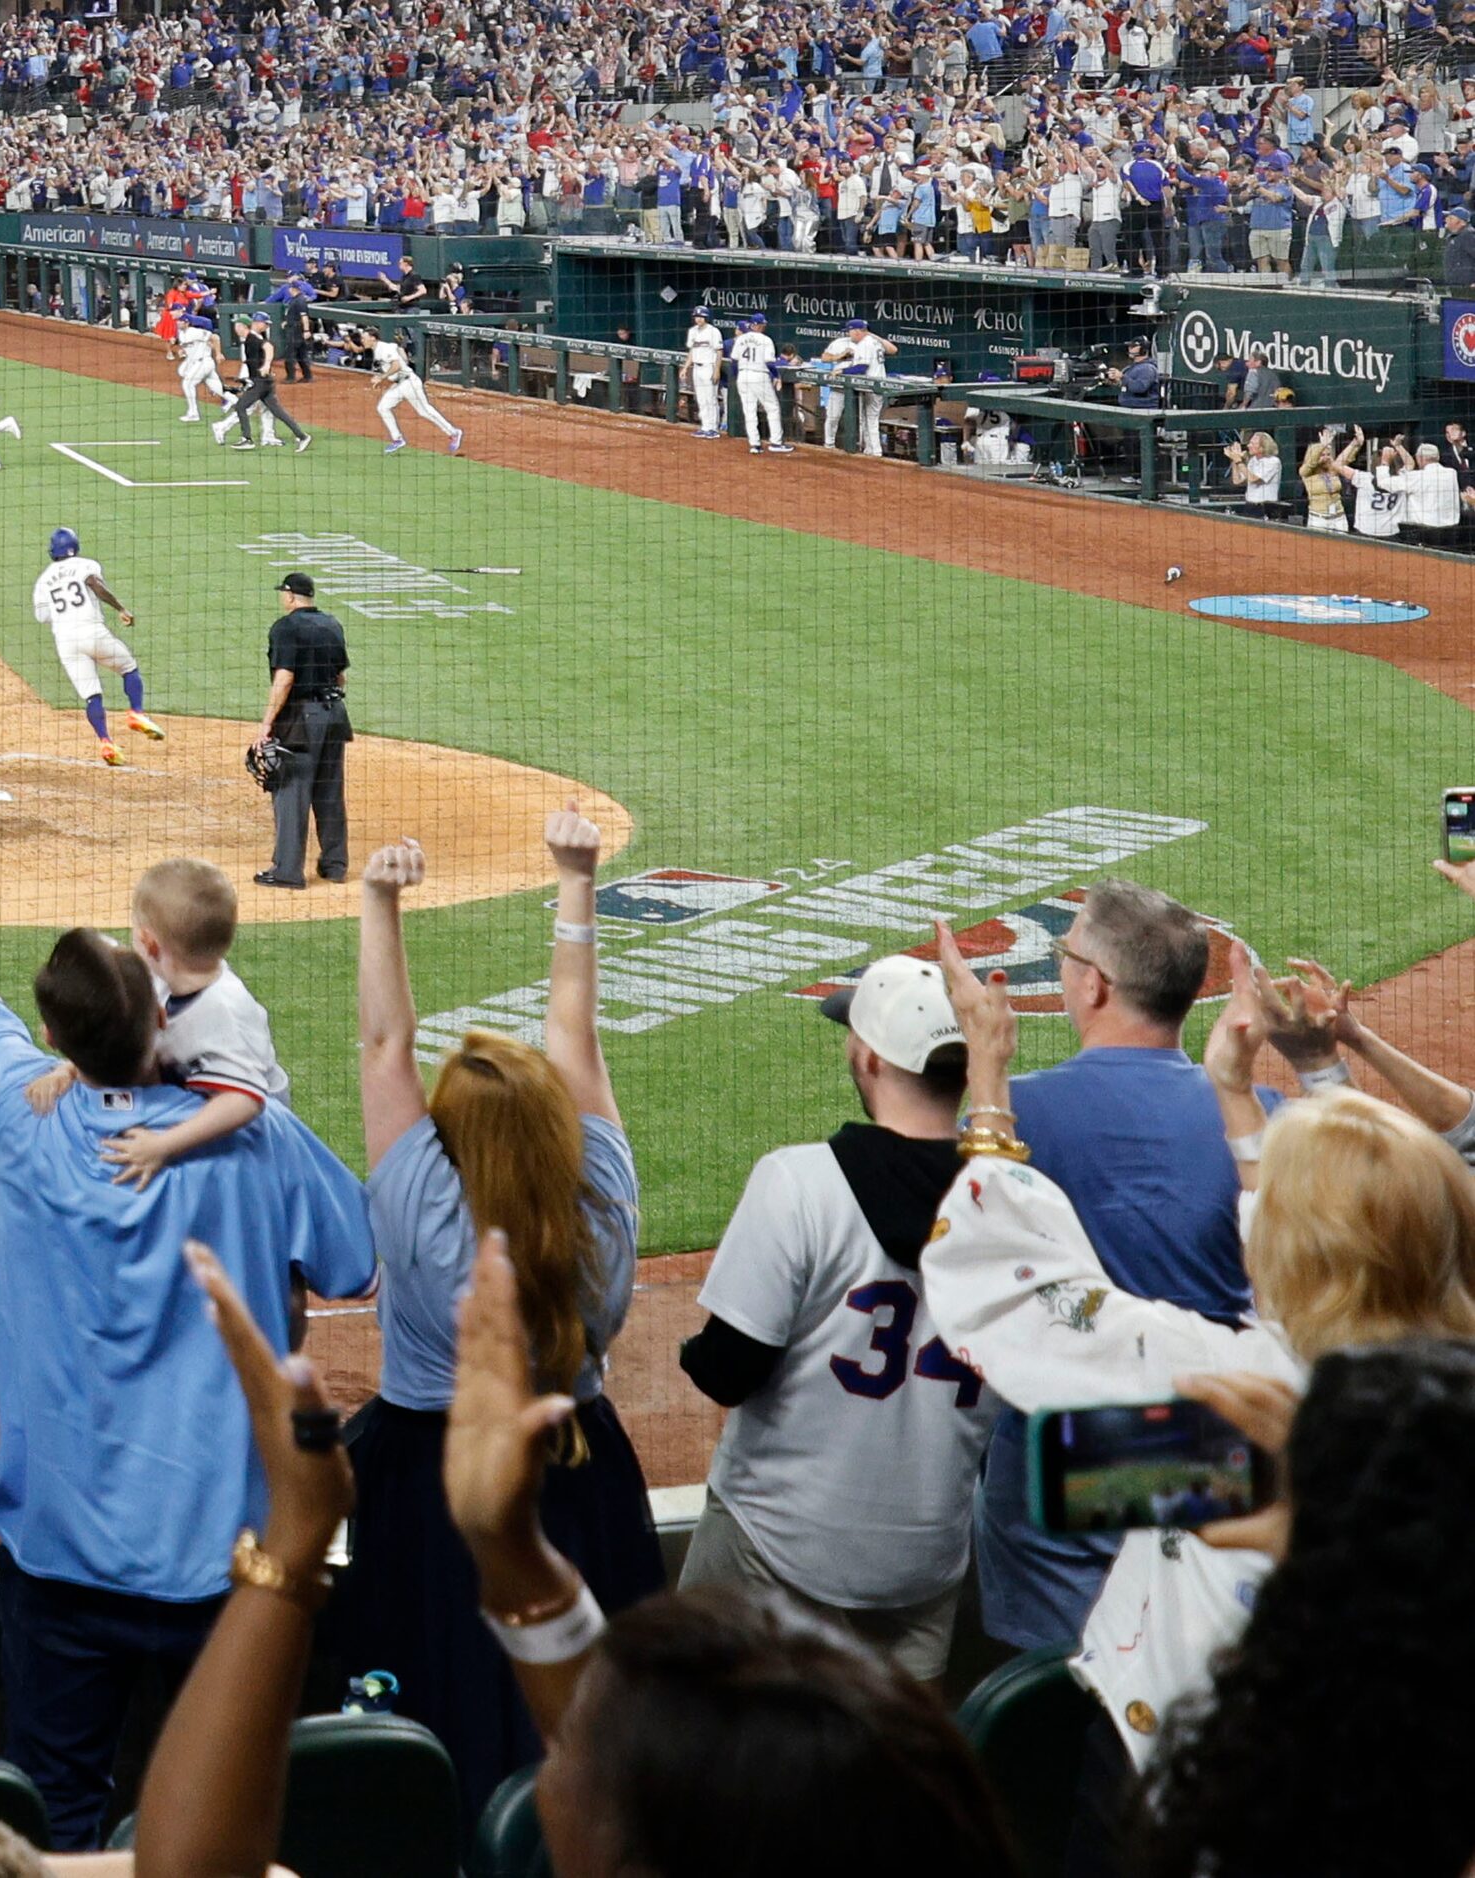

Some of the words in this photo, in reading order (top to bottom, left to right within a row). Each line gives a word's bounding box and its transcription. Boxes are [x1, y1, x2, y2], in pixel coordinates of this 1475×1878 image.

[23, 224, 86, 244] American
[100, 228, 132, 247] American
[147, 232, 182, 251] American
[197, 235, 235, 257] American
[343, 248, 356, 262] FOR
[703, 287, 769, 310] CHOCTAW
[784, 293, 856, 318] CHOCTAW
[875, 299, 955, 325] CHOCTAW
[795, 327, 821, 337] CASINOS
[887, 334, 916, 345] CASINOS
[916, 337, 921, 346] &
[922, 338, 951, 349] RESORTS
[742, 347, 757, 362] 41
[988, 345, 1019, 355] CASINOS
[1224, 328, 1331, 375] Medical
[1333, 338, 1394, 392] City
[1371, 493, 1398, 511] 28
[50, 581, 85, 613] 53
[755, 806, 1211, 933] WEEKEND
[829, 1279, 986, 1408] 34
